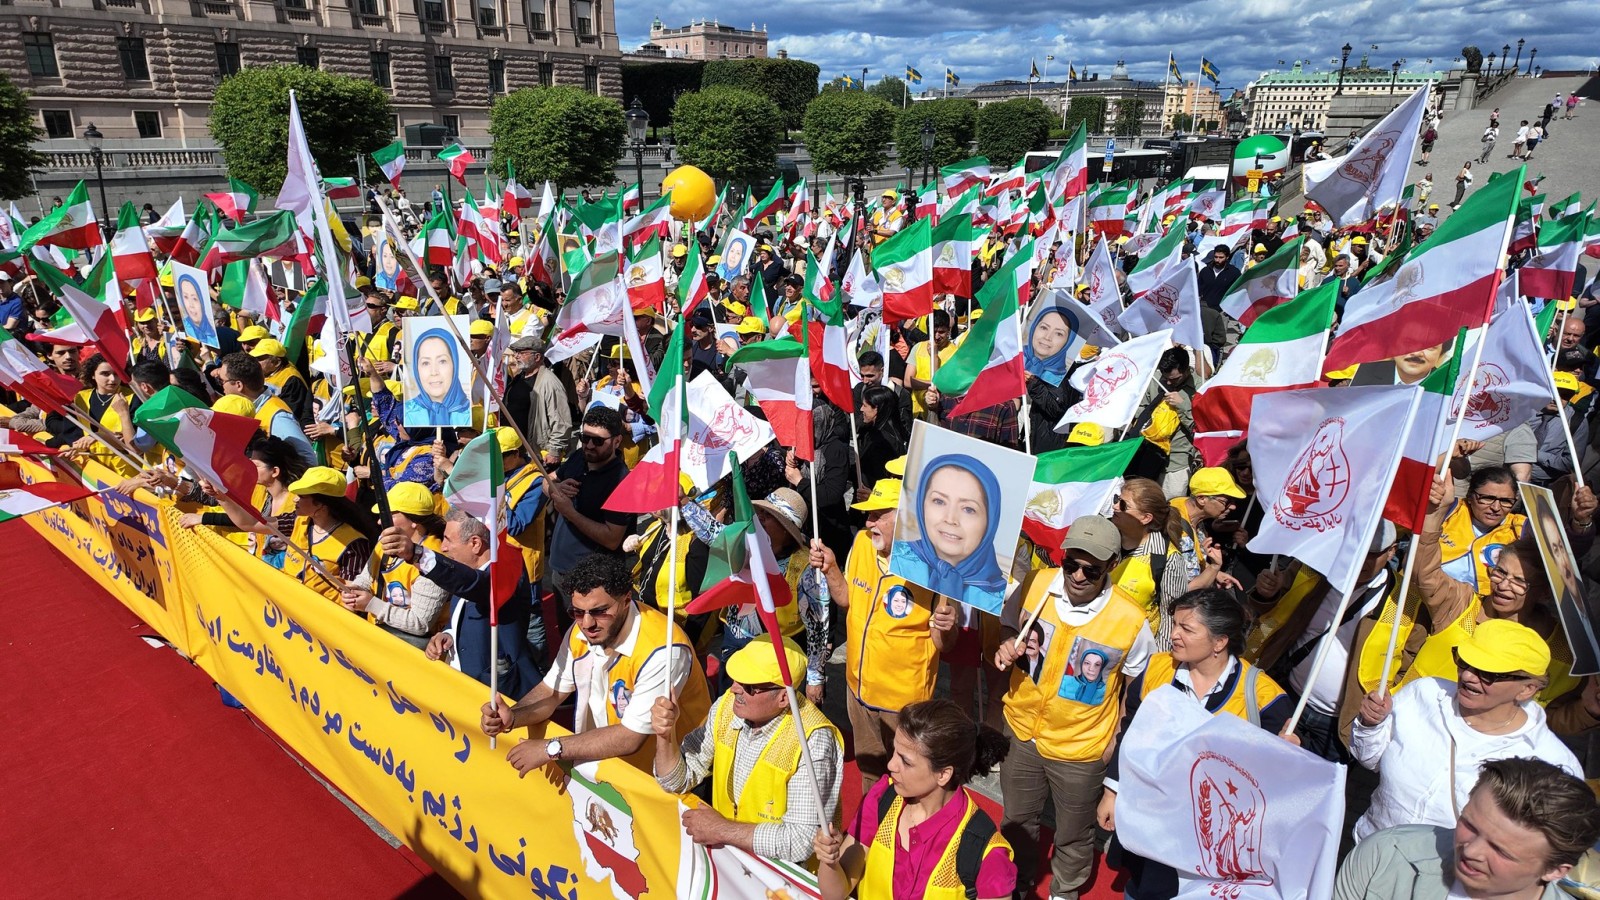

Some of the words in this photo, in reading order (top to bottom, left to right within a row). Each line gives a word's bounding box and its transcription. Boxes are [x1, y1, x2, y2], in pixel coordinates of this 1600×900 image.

[263, 598, 314, 653] بحران
[227, 629, 285, 683] مقاومت
[288, 677, 298, 703] و
[299, 686, 343, 736] مردم
[386, 680, 422, 715] حل
[428, 711, 471, 764] راه
[422, 789, 479, 854] رژیم
